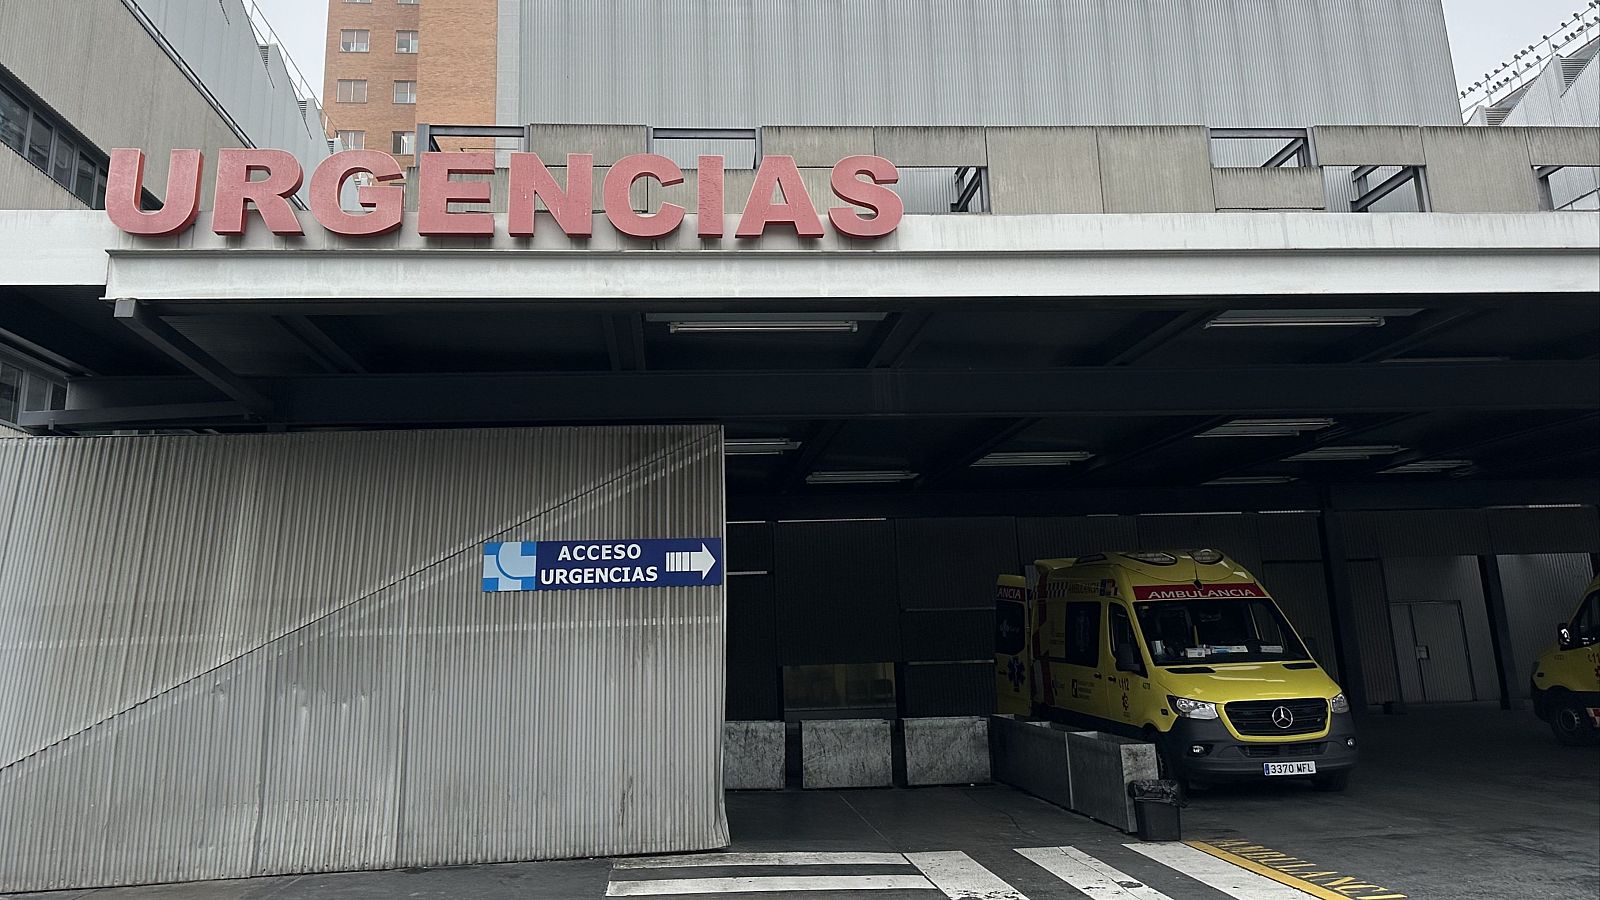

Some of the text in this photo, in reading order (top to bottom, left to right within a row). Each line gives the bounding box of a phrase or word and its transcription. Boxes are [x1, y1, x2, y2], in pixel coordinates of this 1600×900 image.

[105, 147, 904, 238] URGENCIAS
[558, 543, 641, 561] ACCESO
[540, 566, 658, 585] URGENCIAS
[997, 587, 1021, 600] ANCIA
[1148, 588, 1256, 599] AMBULANCIA
[1270, 763, 1314, 774] 3370 MFL
